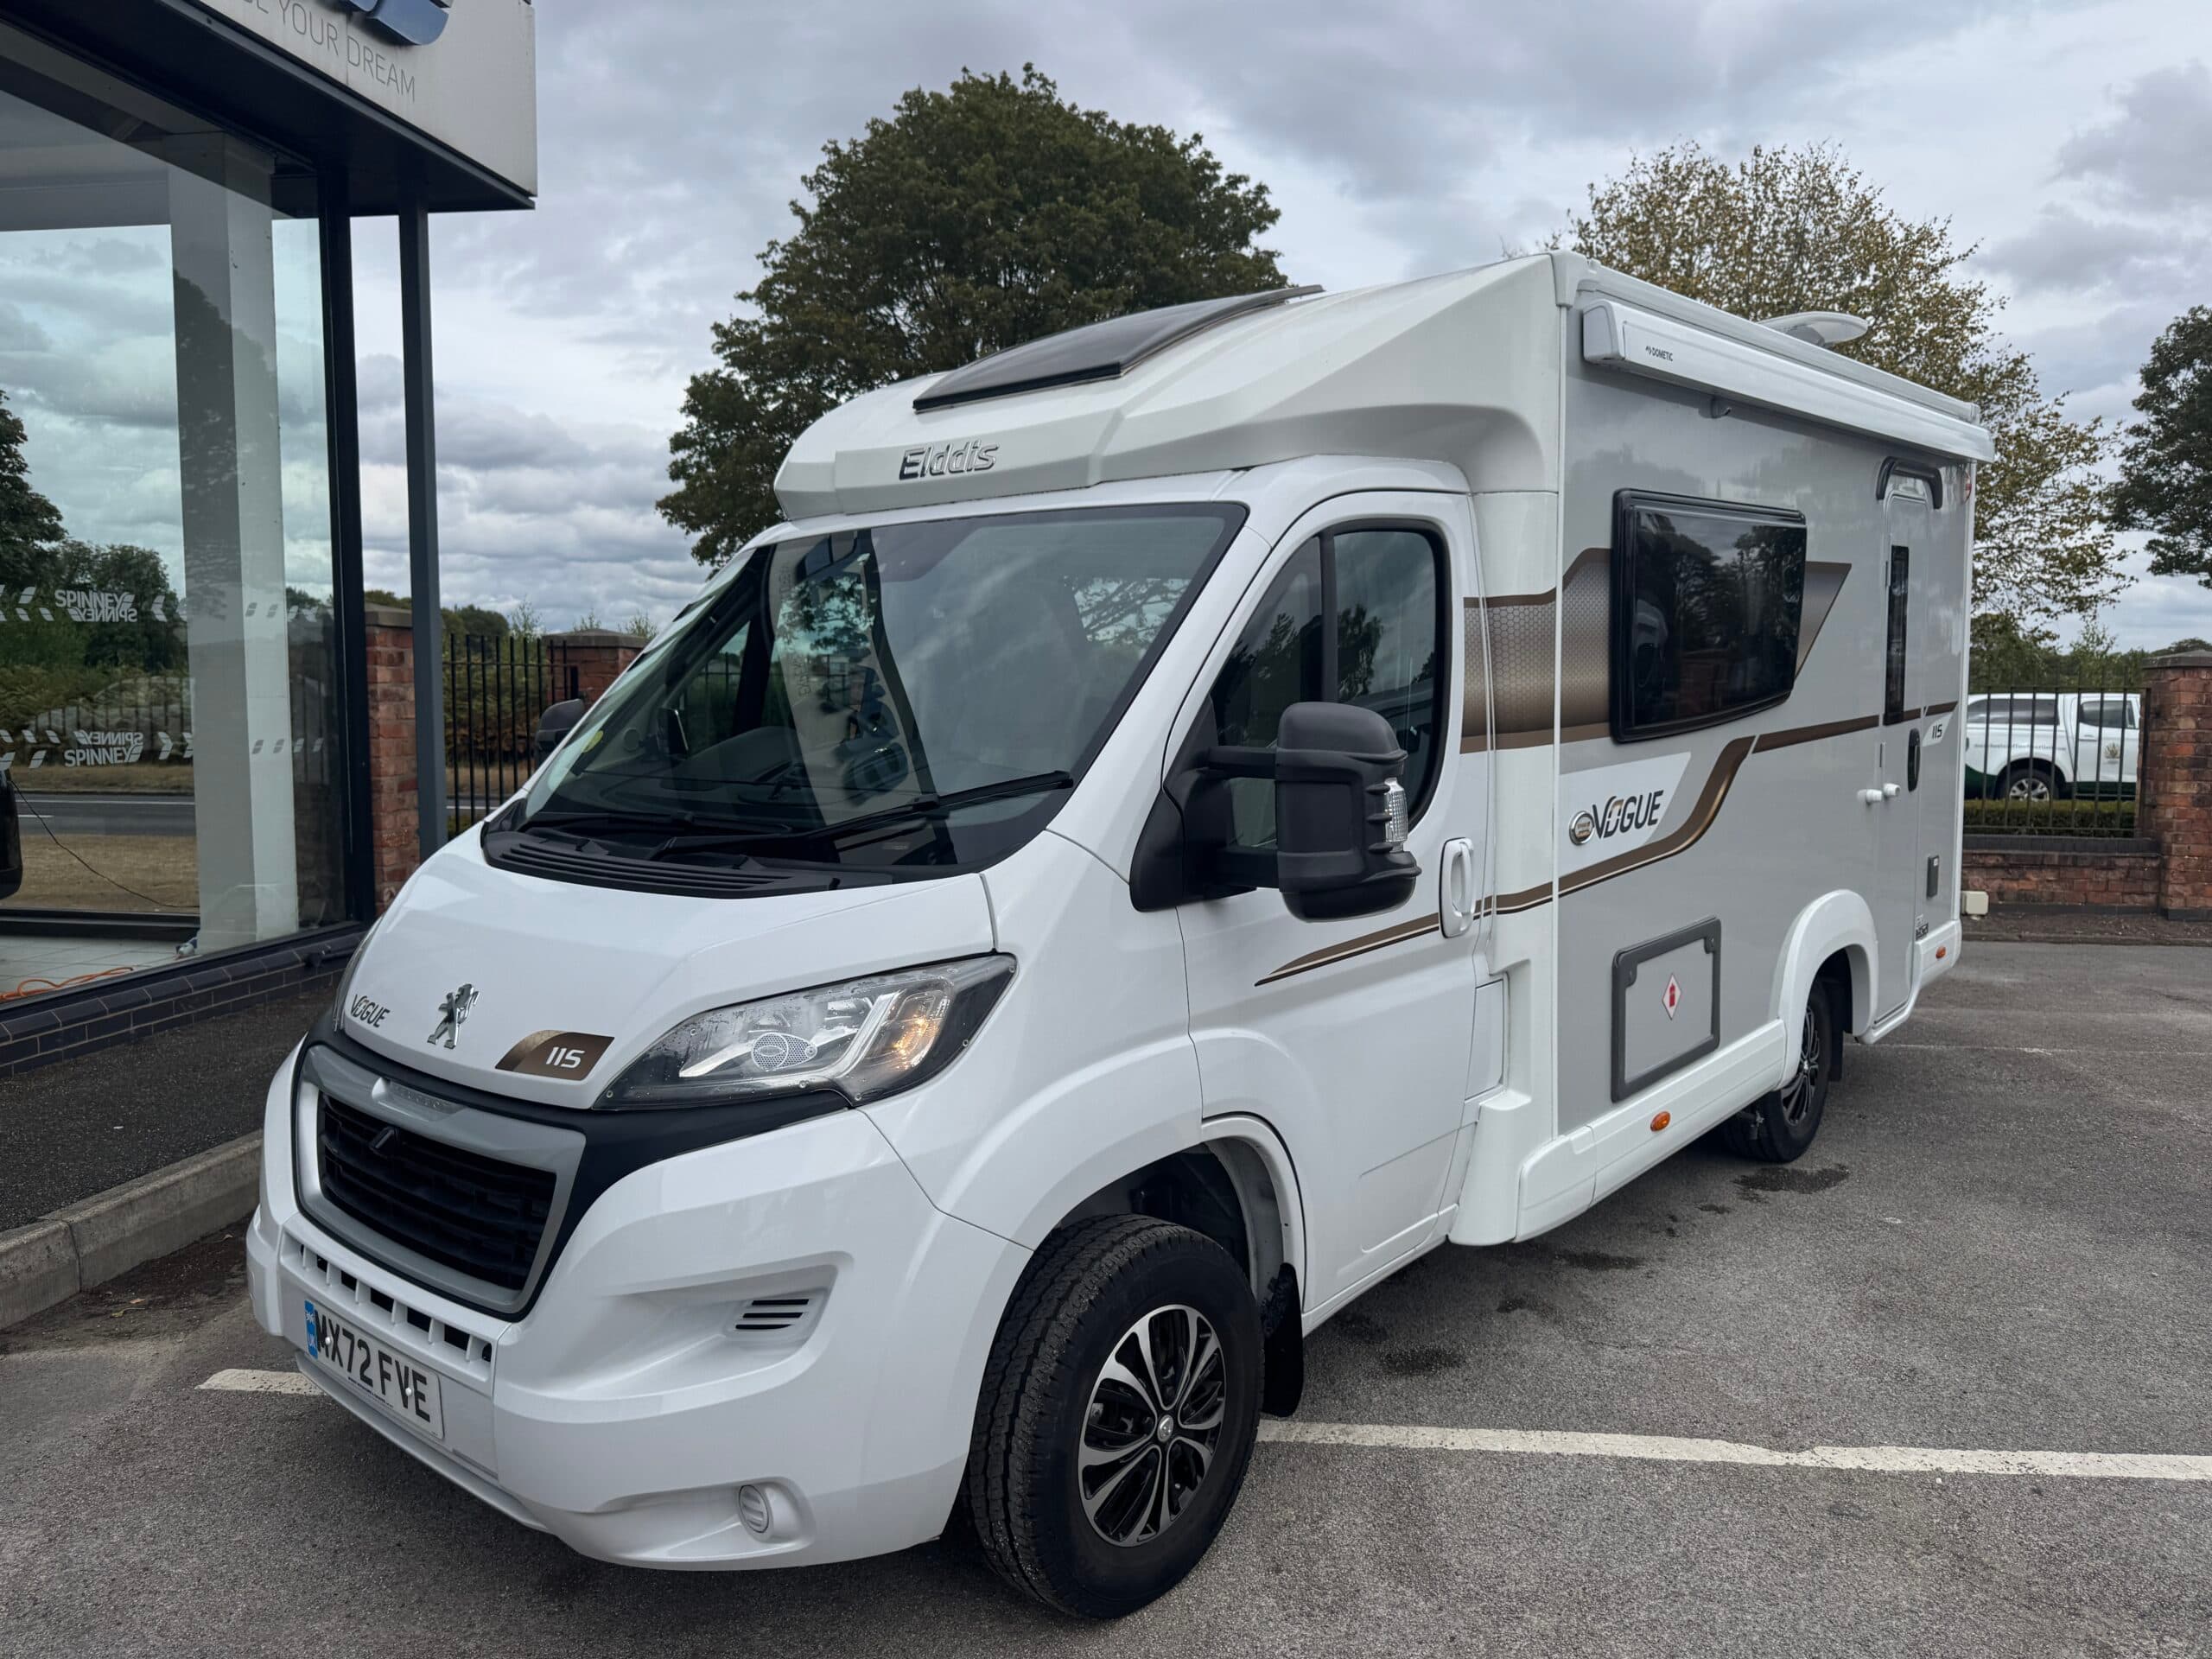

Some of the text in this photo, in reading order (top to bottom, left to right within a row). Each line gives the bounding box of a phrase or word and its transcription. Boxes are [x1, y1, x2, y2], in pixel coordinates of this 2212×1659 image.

[279, 0, 339, 55] YOUR
[346, 35, 416, 103] DREAM
[1651, 346, 1674, 362] DOMETIC
[899, 439, 1000, 480] Elddis
[54, 589, 136, 608] SPINNEY
[1932, 723, 1943, 740] 115
[64, 745, 143, 767] SPINNEY
[1592, 790, 1664, 839] VOGUE
[350, 994, 391, 1028] VOGUE
[545, 1046, 586, 1070] 115
[378, 1350, 431, 1423] FVE
